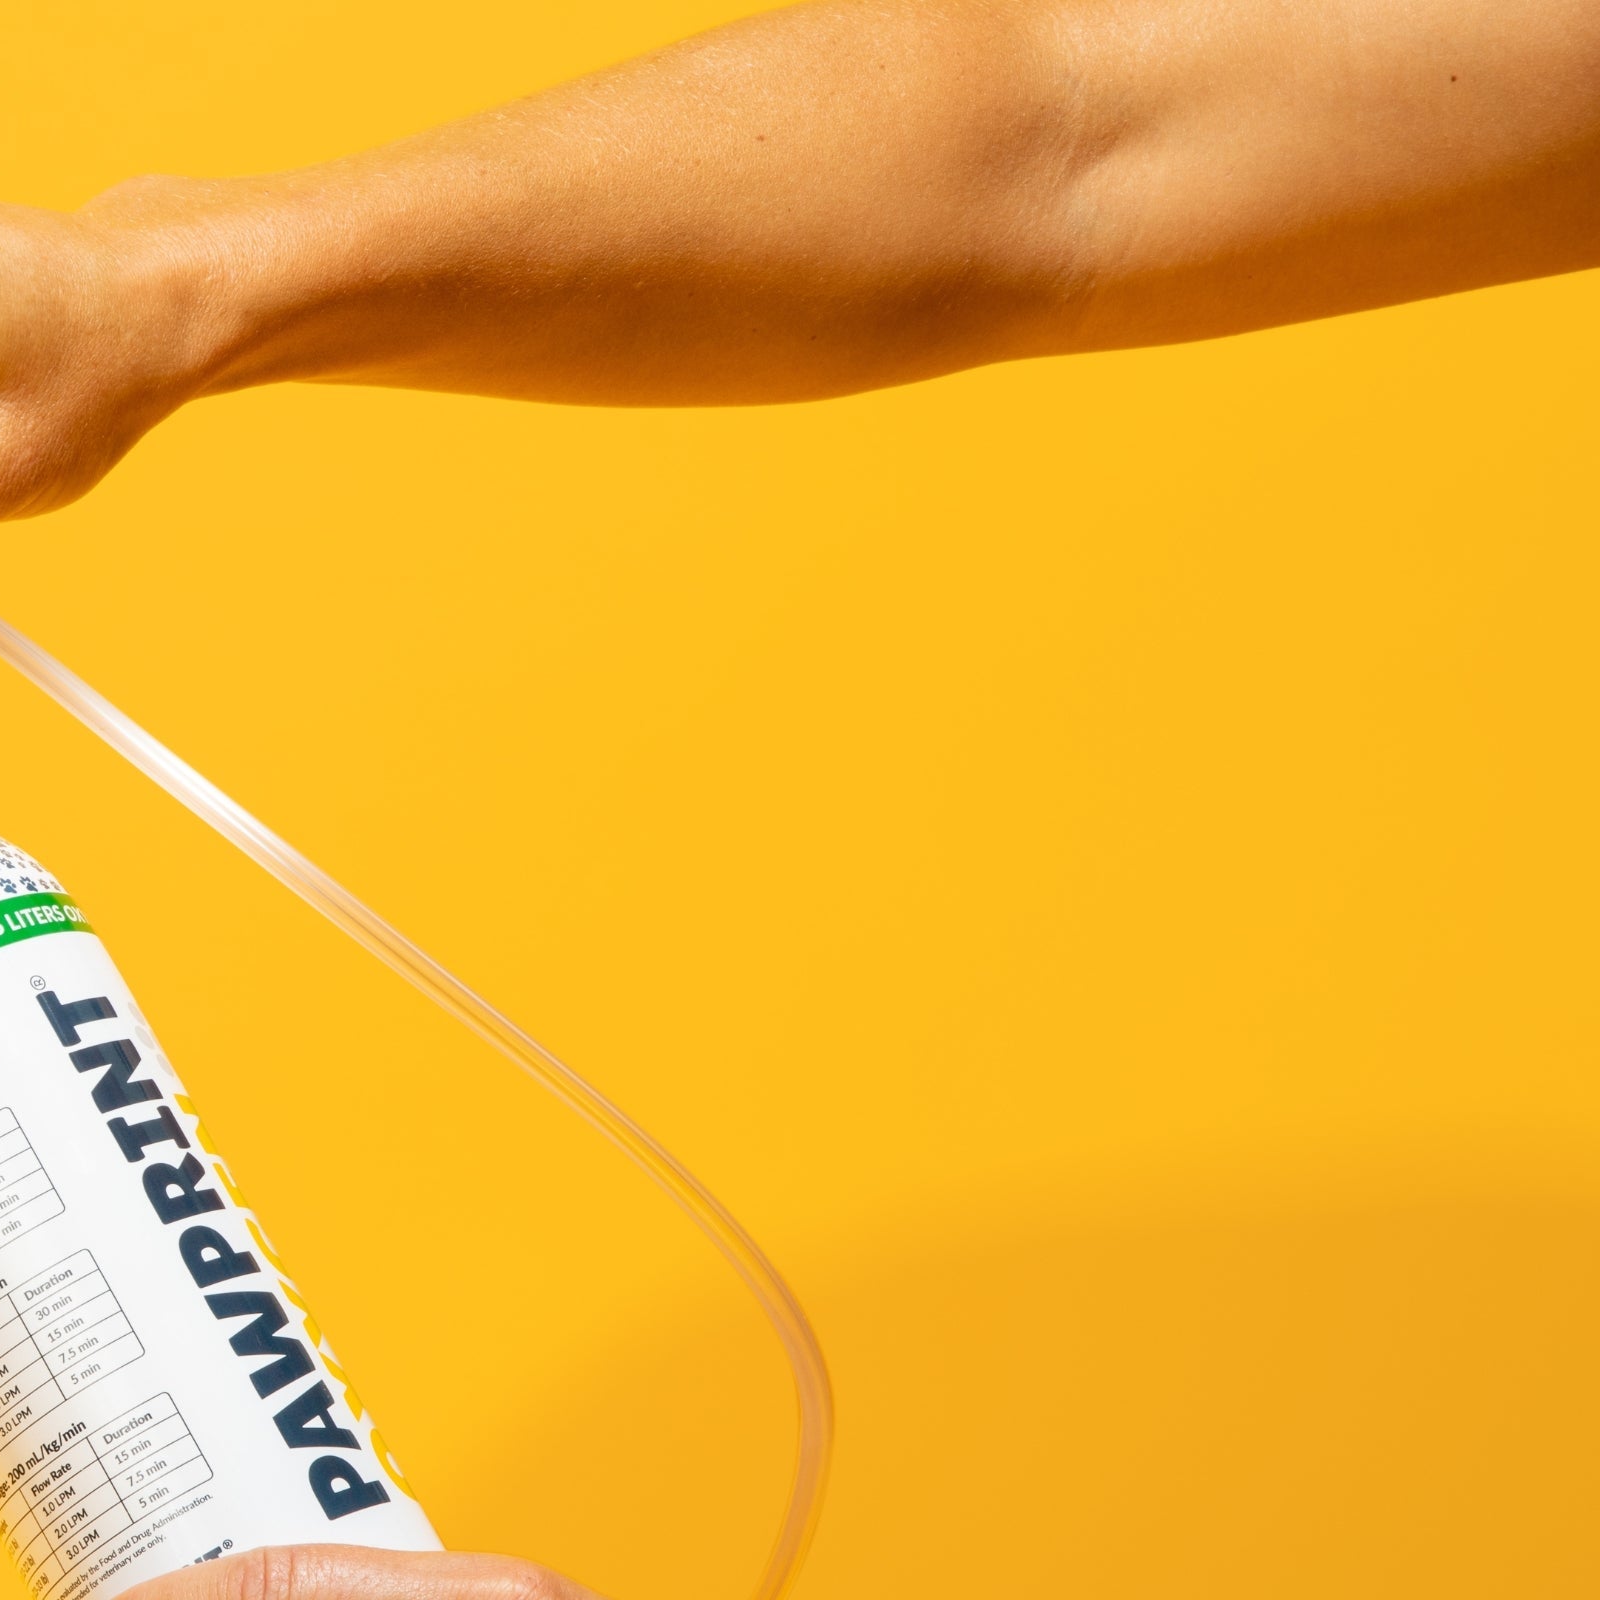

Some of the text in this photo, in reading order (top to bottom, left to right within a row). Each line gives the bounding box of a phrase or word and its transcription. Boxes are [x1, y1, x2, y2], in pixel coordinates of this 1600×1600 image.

[4, 905, 65, 931] LITERS
[1, 1218, 22, 1235] min
[23, 1267, 73, 1301] Duration
[35, 1293, 73, 1321] 30 min
[48, 1316, 84, 1343] 15 min
[58, 1335, 99, 1364] 7.5 min
[70, 1361, 101, 1385] 5 min
[0, 1385, 21, 1407] LPM
[0, 1406, 33, 1437] 3.0 LPM
[102, 1411, 152, 1444] Duration
[8, 1464, 25, 1485] 200
[24, 1420, 86, 1472] mL/kg/min
[115, 1438, 152, 1465] 15 min
[30, 1461, 72, 1497] Flow Rate
[126, 1458, 167, 1487] 7.5 min
[42, 1486, 76, 1518] 1.0 LPM
[138, 1485, 169, 1509] 5 min
[54, 1508, 88, 1539] 2.0 LPM
[82, 1572, 89, 1582] by
[88, 1564, 99, 1576] the
[99, 1549, 117, 1567] Food
[117, 1540, 131, 1553] and
[131, 1527, 152, 1544] Drug
[152, 1494, 213, 1532] Administration.
[66, 1530, 100, 1561] 3.0 LPM
[72, 1533, 167, 1600] tended for veterinary use only.
